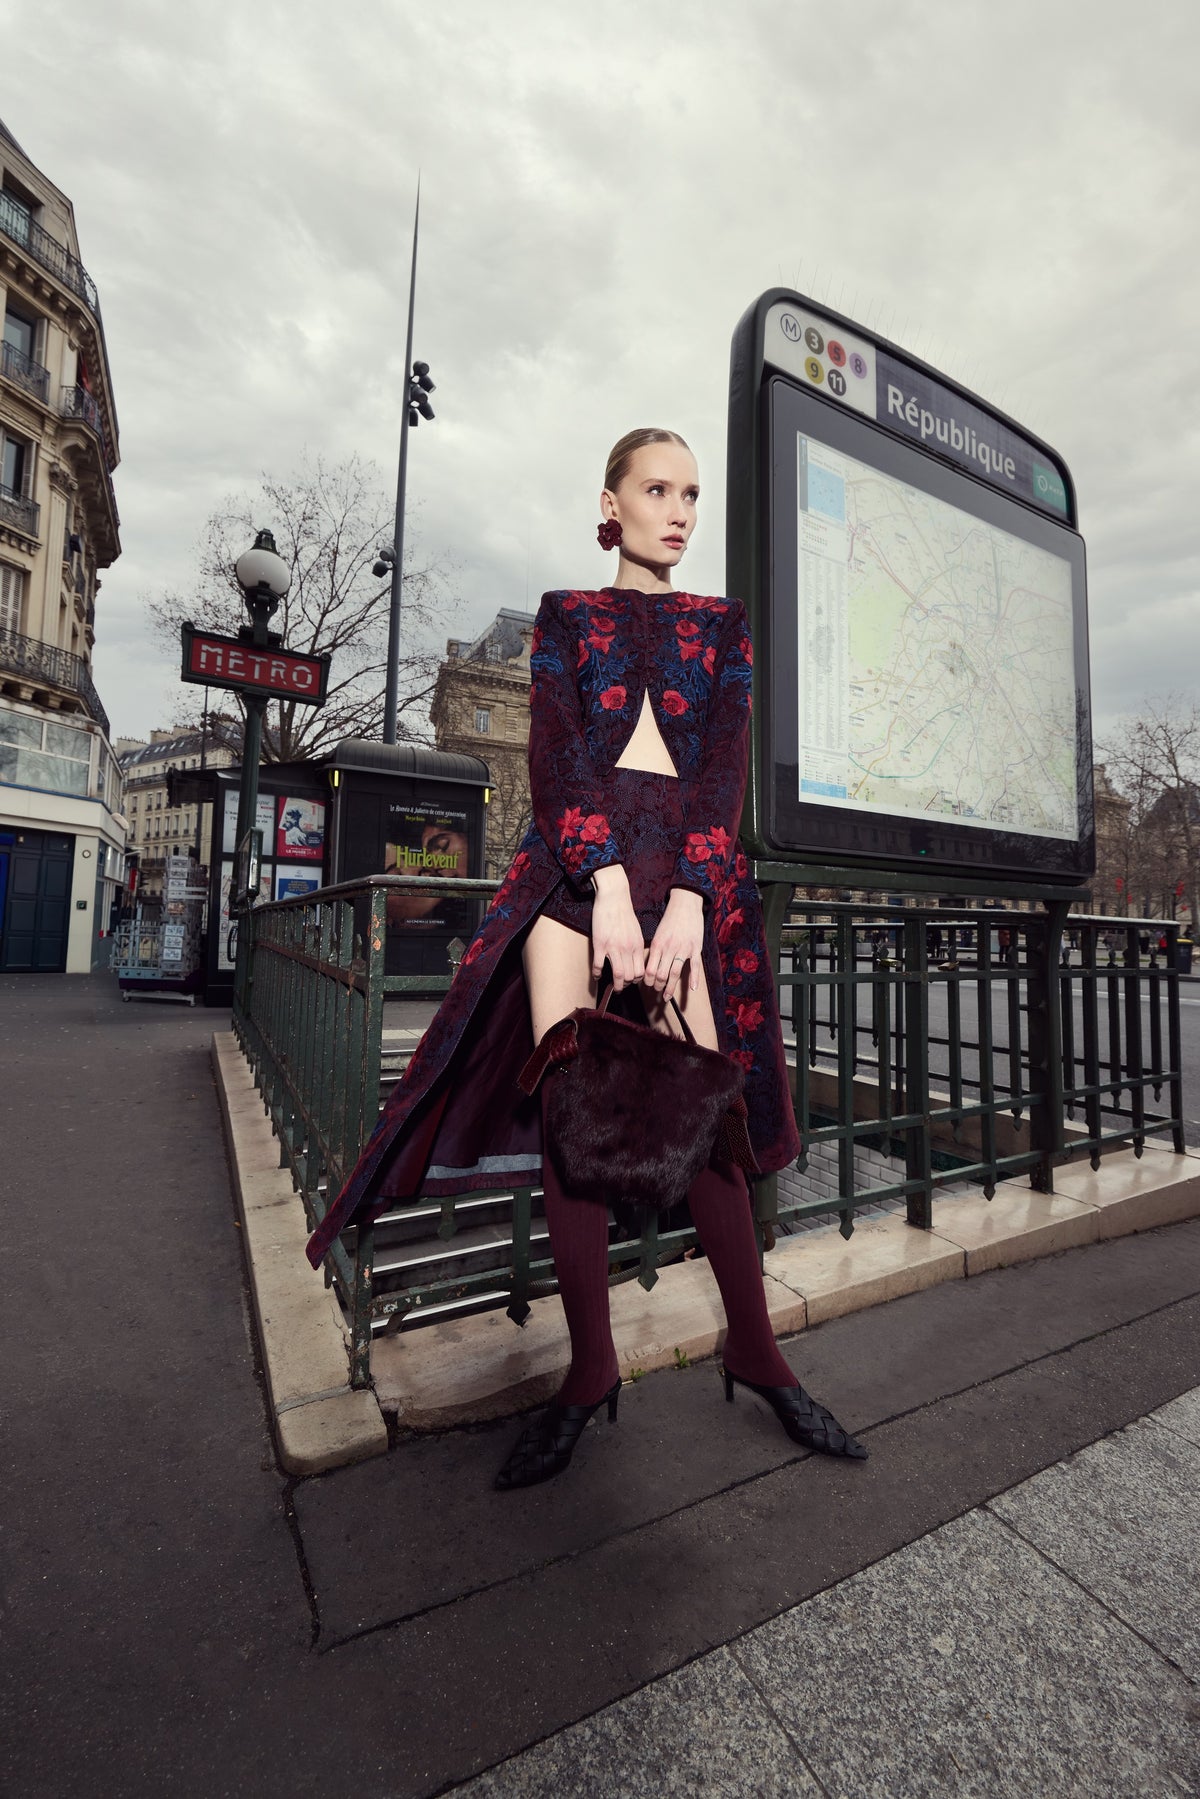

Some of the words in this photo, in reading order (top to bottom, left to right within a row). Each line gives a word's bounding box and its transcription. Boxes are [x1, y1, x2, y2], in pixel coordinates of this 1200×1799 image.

[785, 318, 797, 337] M
[810, 332, 819, 349] 3
[833, 346, 841, 362] 5
[854, 358, 863, 374] 8
[810, 362, 819, 378] 9
[829, 373, 843, 392] 11
[887, 383, 1016, 480] République
[200, 644, 313, 689] METRO
